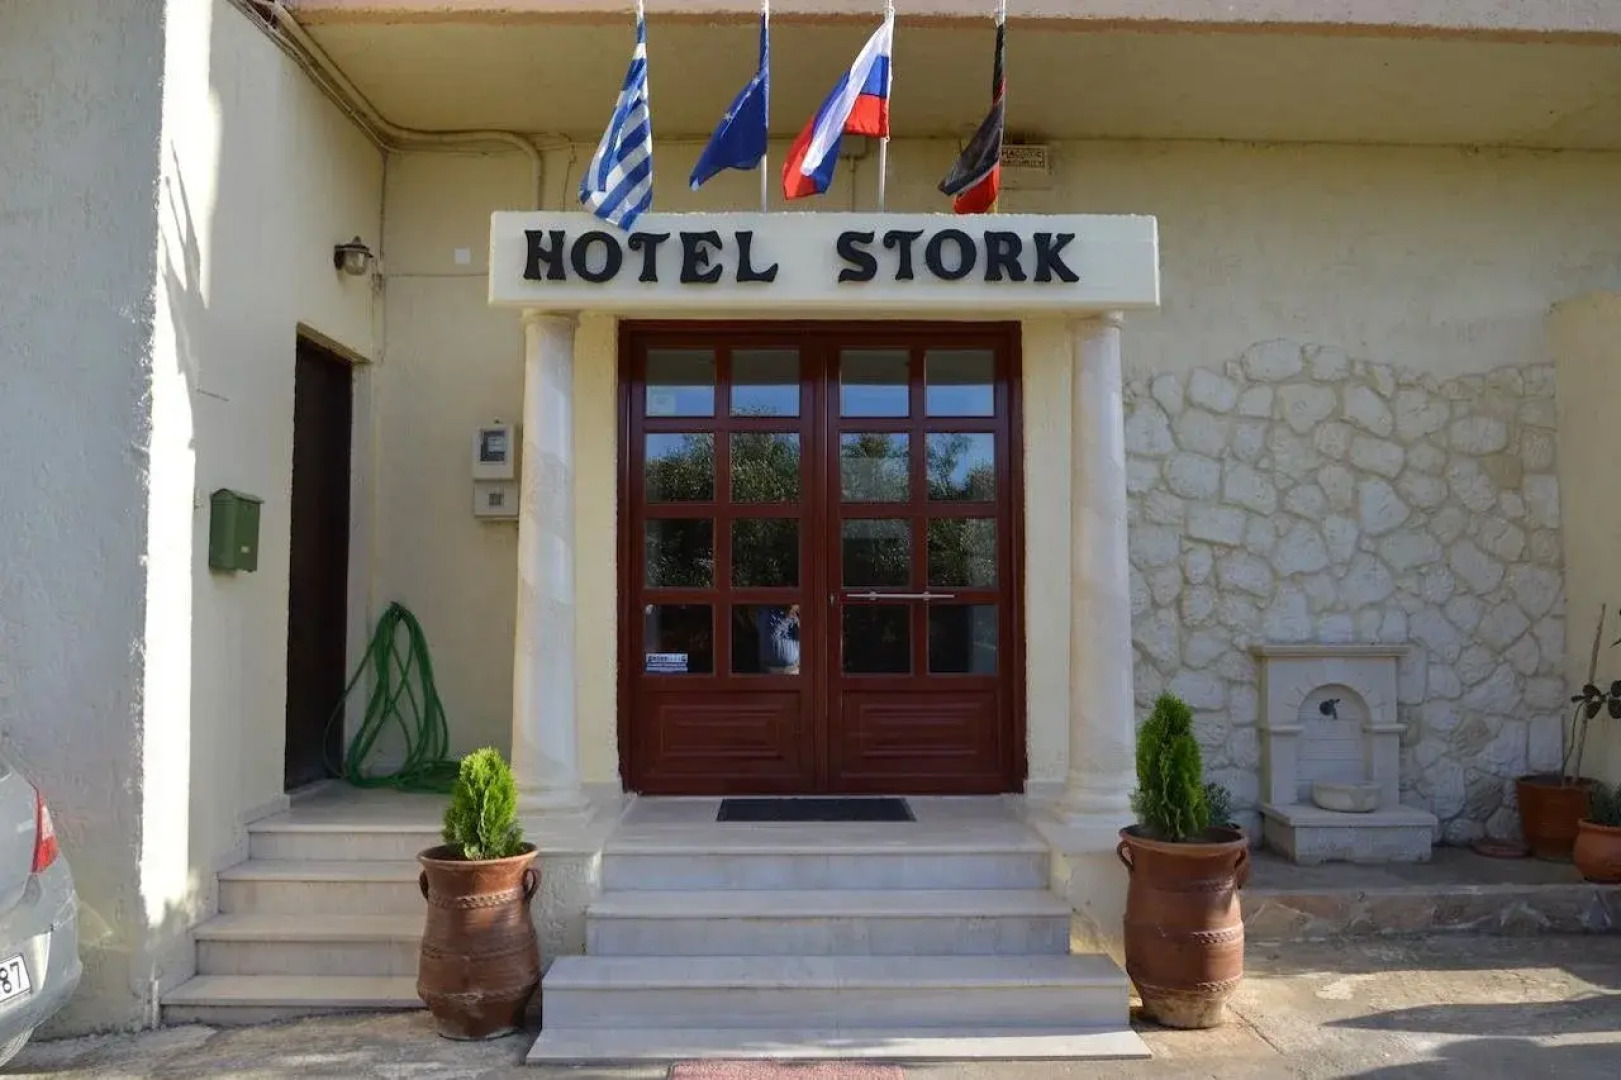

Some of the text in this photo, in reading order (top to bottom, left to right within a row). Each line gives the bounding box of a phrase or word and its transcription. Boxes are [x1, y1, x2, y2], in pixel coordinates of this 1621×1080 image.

[523, 228, 1080, 283] HOTEL STORK
[0, 961, 21, 994] 87
